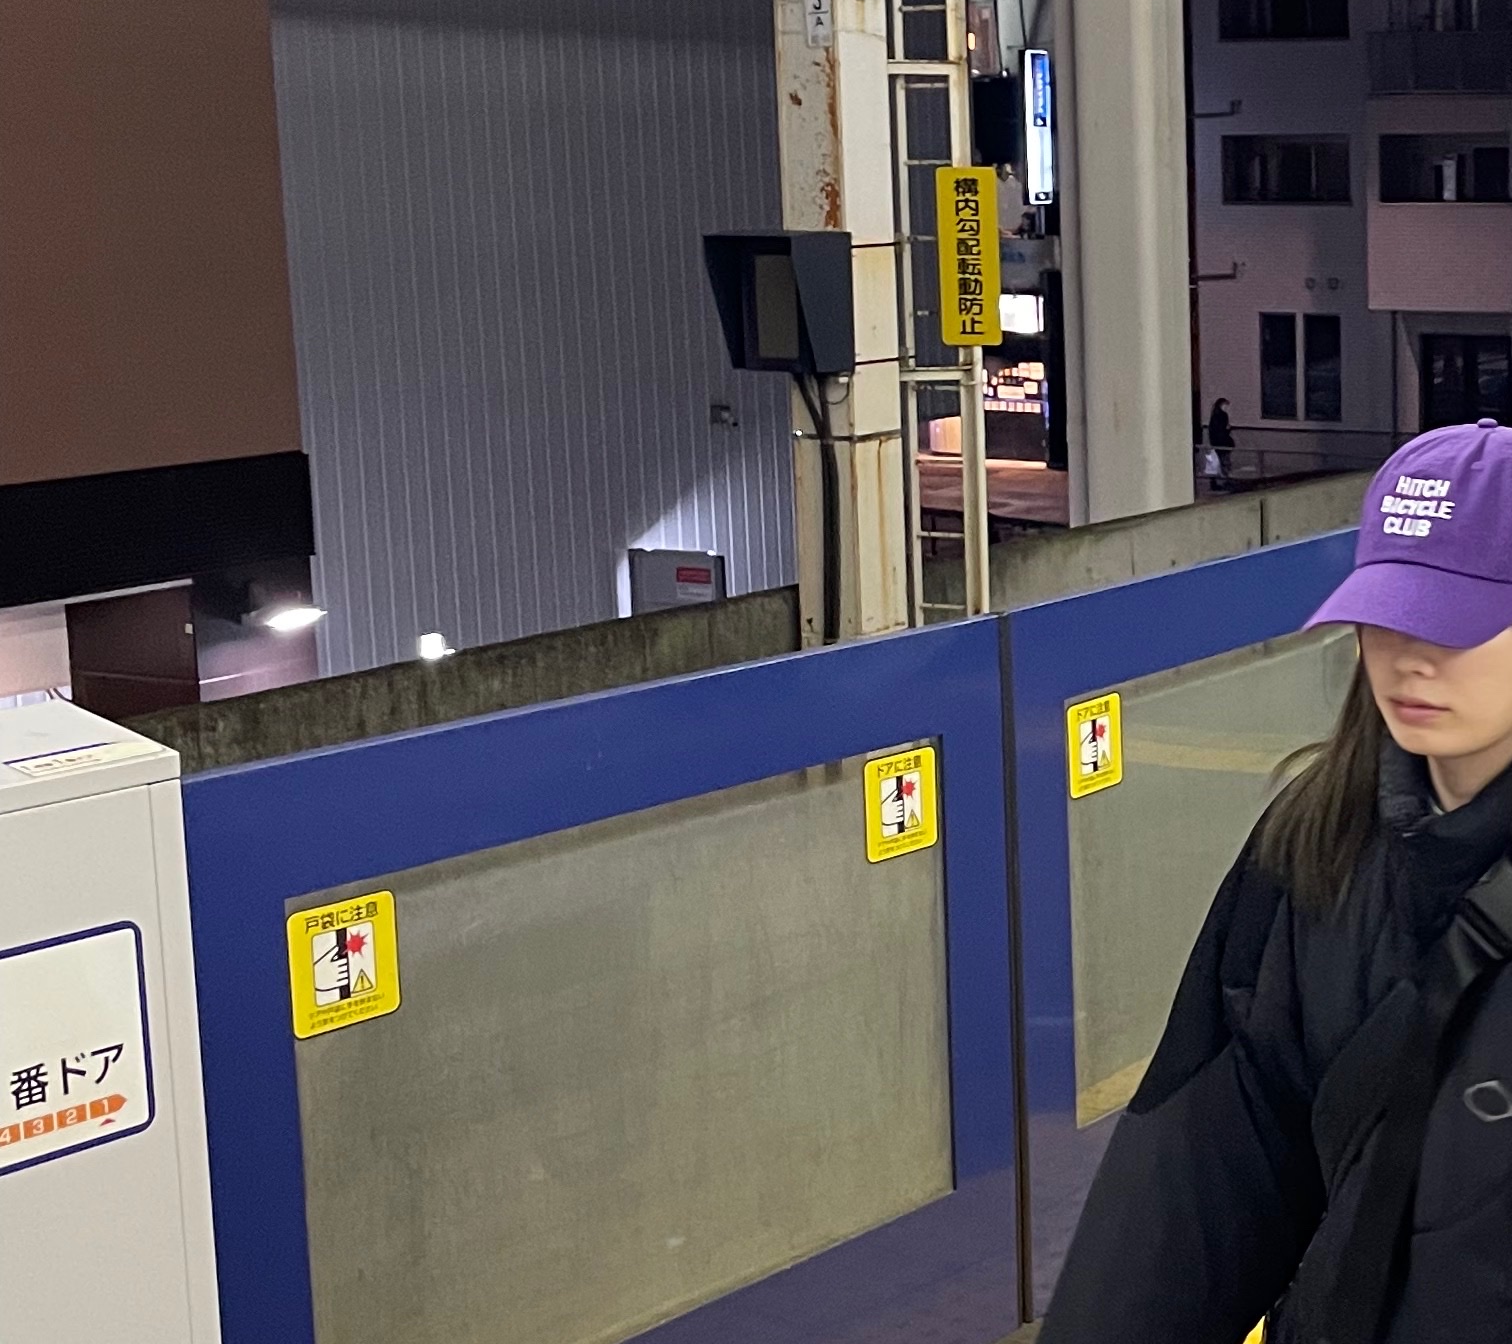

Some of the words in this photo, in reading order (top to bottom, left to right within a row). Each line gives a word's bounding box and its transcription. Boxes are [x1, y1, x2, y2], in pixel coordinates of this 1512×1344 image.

[815, 16, 824, 27] A
[954, 178, 985, 335] 構内勾配転動防止
[1396, 476, 1451, 497] HITCH
[1380, 495, 1456, 520] BICYCLE
[1383, 516, 1432, 537] CLUB
[32, 1119, 44, 1134] 3
[66, 1109, 77, 1124] 2
